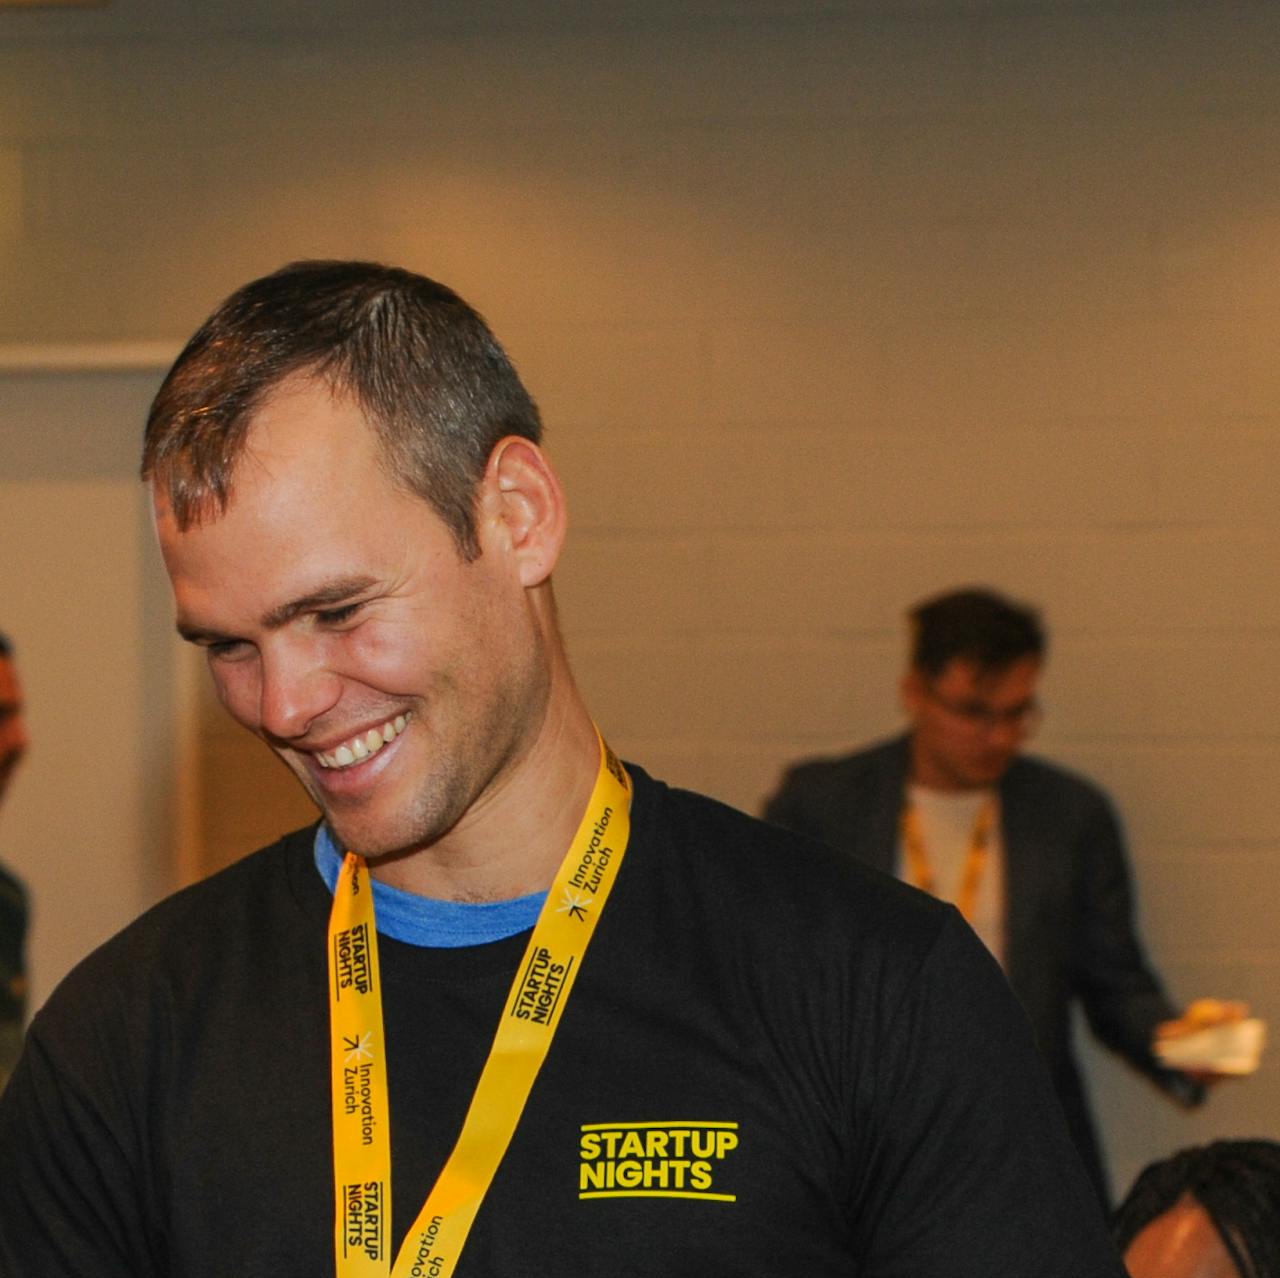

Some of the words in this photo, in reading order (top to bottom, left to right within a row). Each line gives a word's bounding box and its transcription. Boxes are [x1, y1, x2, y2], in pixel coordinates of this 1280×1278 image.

[567, 806, 614, 888] Innovation
[585, 846, 615, 896] Zurich
[338, 929, 354, 990] NIGHTS
[351, 923, 369, 995] STARTUP
[514, 948, 552, 1021] STARTUP
[532, 962, 565, 1024] NIGHTS
[344, 1066, 357, 1116] Zurich
[359, 1062, 374, 1146] Innovation
[580, 1130, 738, 1160] STARTUP
[580, 1160, 713, 1190] NIGHTS
[347, 1183, 363, 1247] NIGHTS
[363, 1181, 379, 1261] STARTUP
